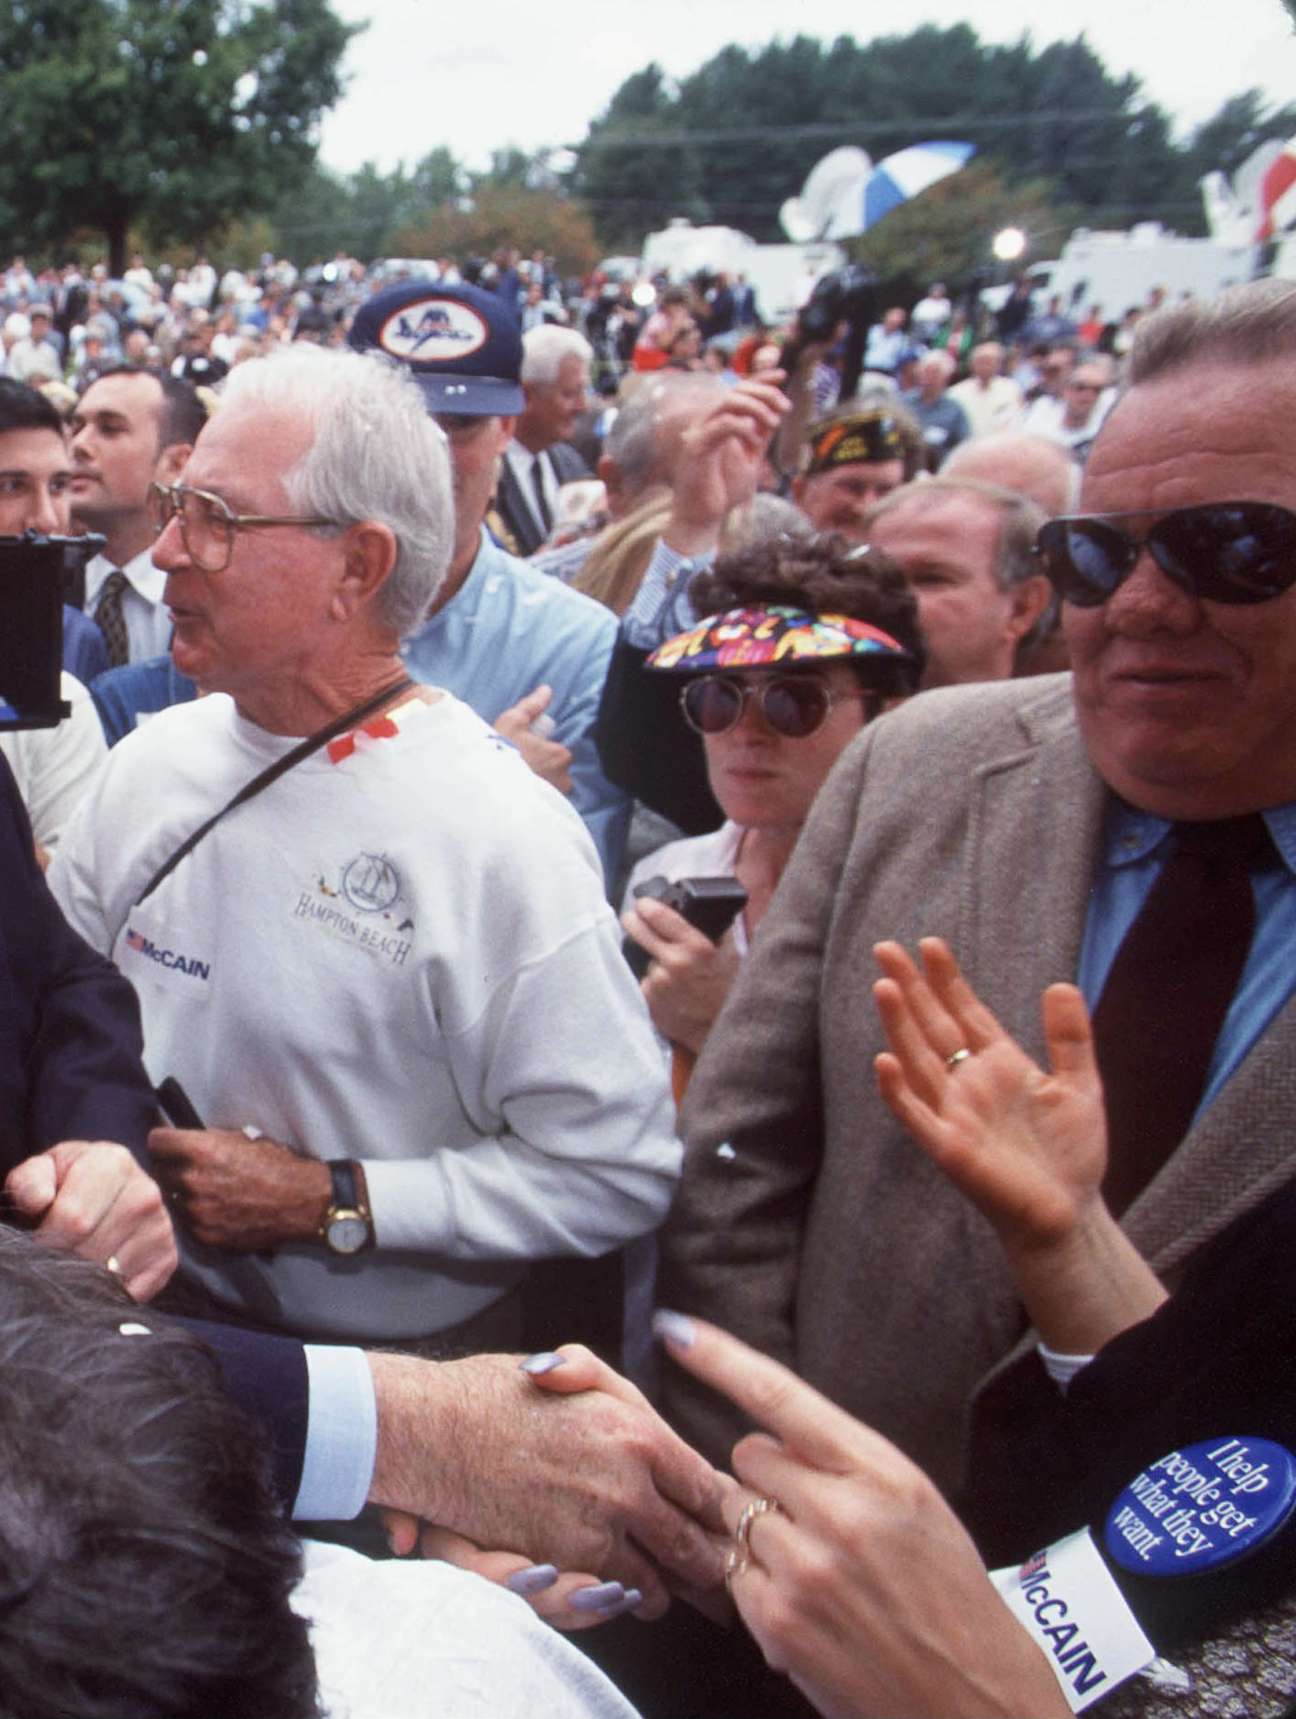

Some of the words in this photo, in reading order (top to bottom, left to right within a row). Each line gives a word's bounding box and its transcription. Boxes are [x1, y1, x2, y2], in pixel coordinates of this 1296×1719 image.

[141, 937, 211, 981] McCAIN
[294, 892, 360, 936] HAMPTON
[359, 926, 412, 966] BEACH
[1206, 1439, 1241, 1460] I
[1216, 1446, 1269, 1495] help
[1128, 1472, 1179, 1519] what
[1162, 1509, 1214, 1558] they
[1150, 1451, 1221, 1506] people
[1199, 1499, 1258, 1538] get
[1112, 1505, 1163, 1561] want.
[1019, 1569, 1108, 1697] McCAIN
